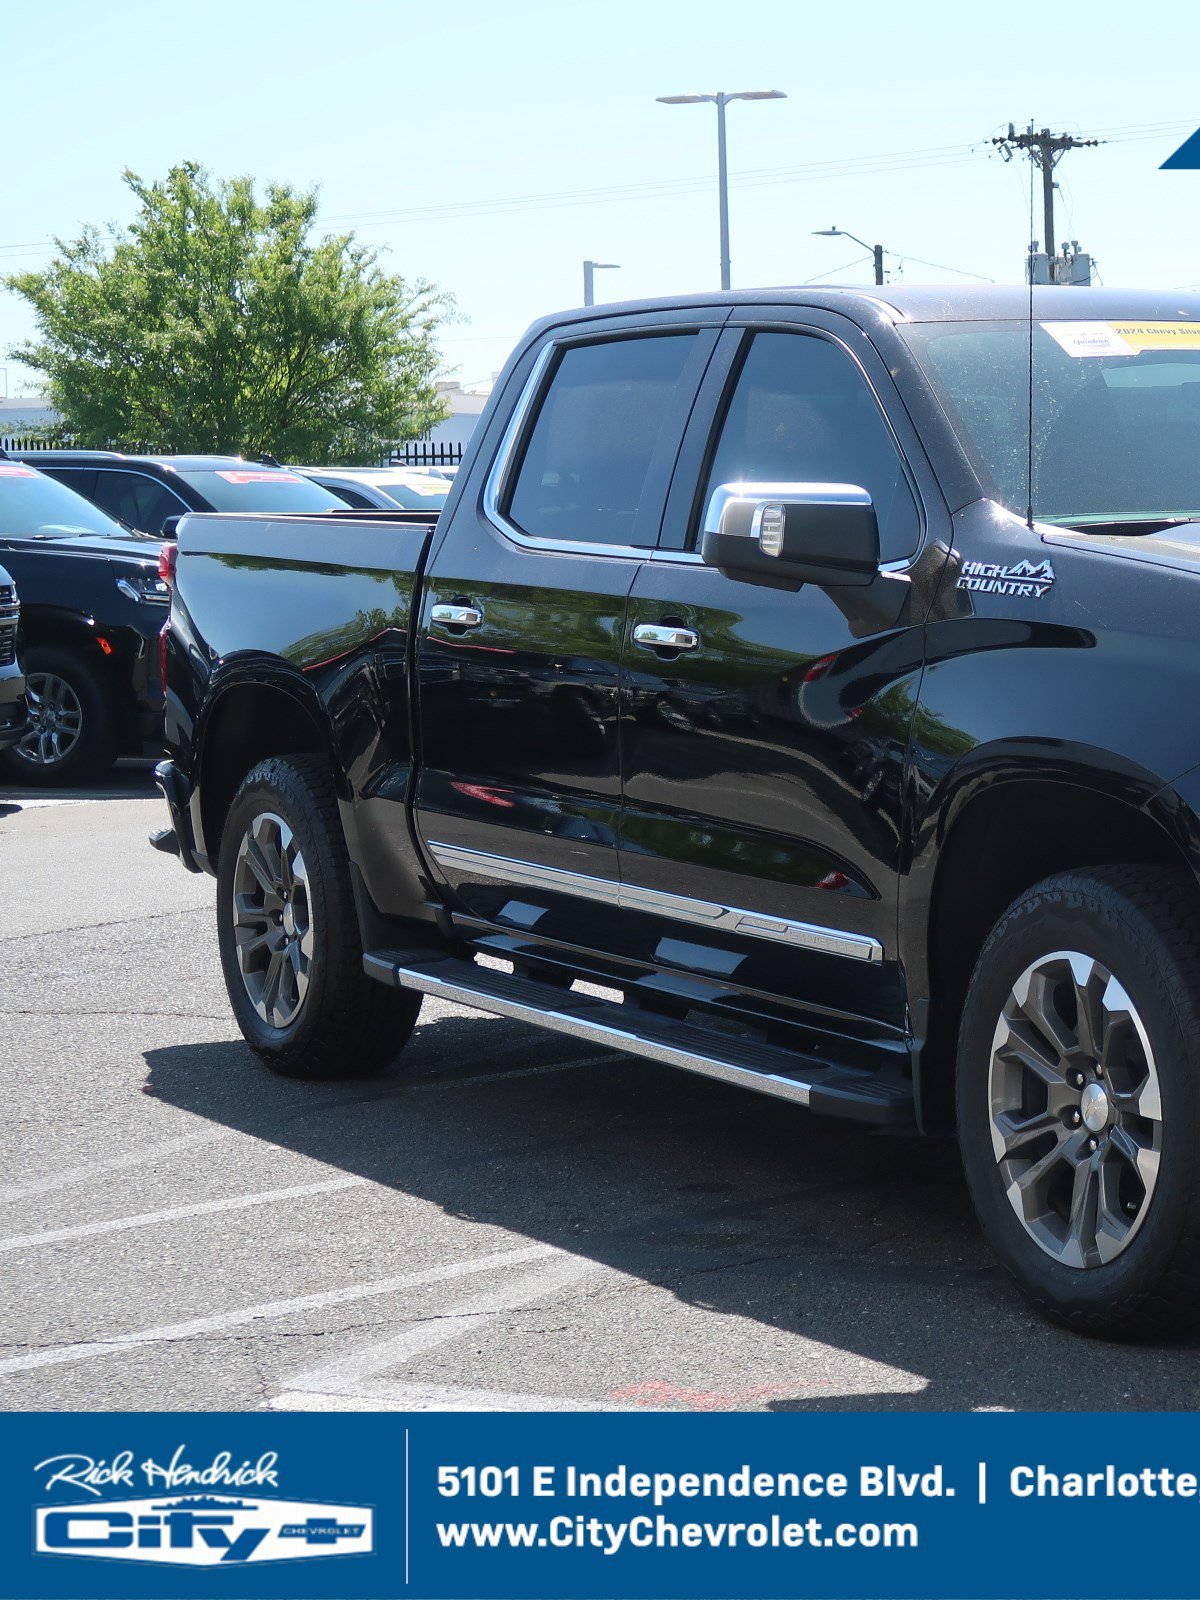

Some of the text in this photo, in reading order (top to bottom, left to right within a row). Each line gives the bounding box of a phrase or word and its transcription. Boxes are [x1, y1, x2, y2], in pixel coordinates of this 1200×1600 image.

[1146, 328, 1177, 336] Chevy
[961, 561, 1008, 578] HIGH
[956, 576, 1051, 599] COUNTRY
